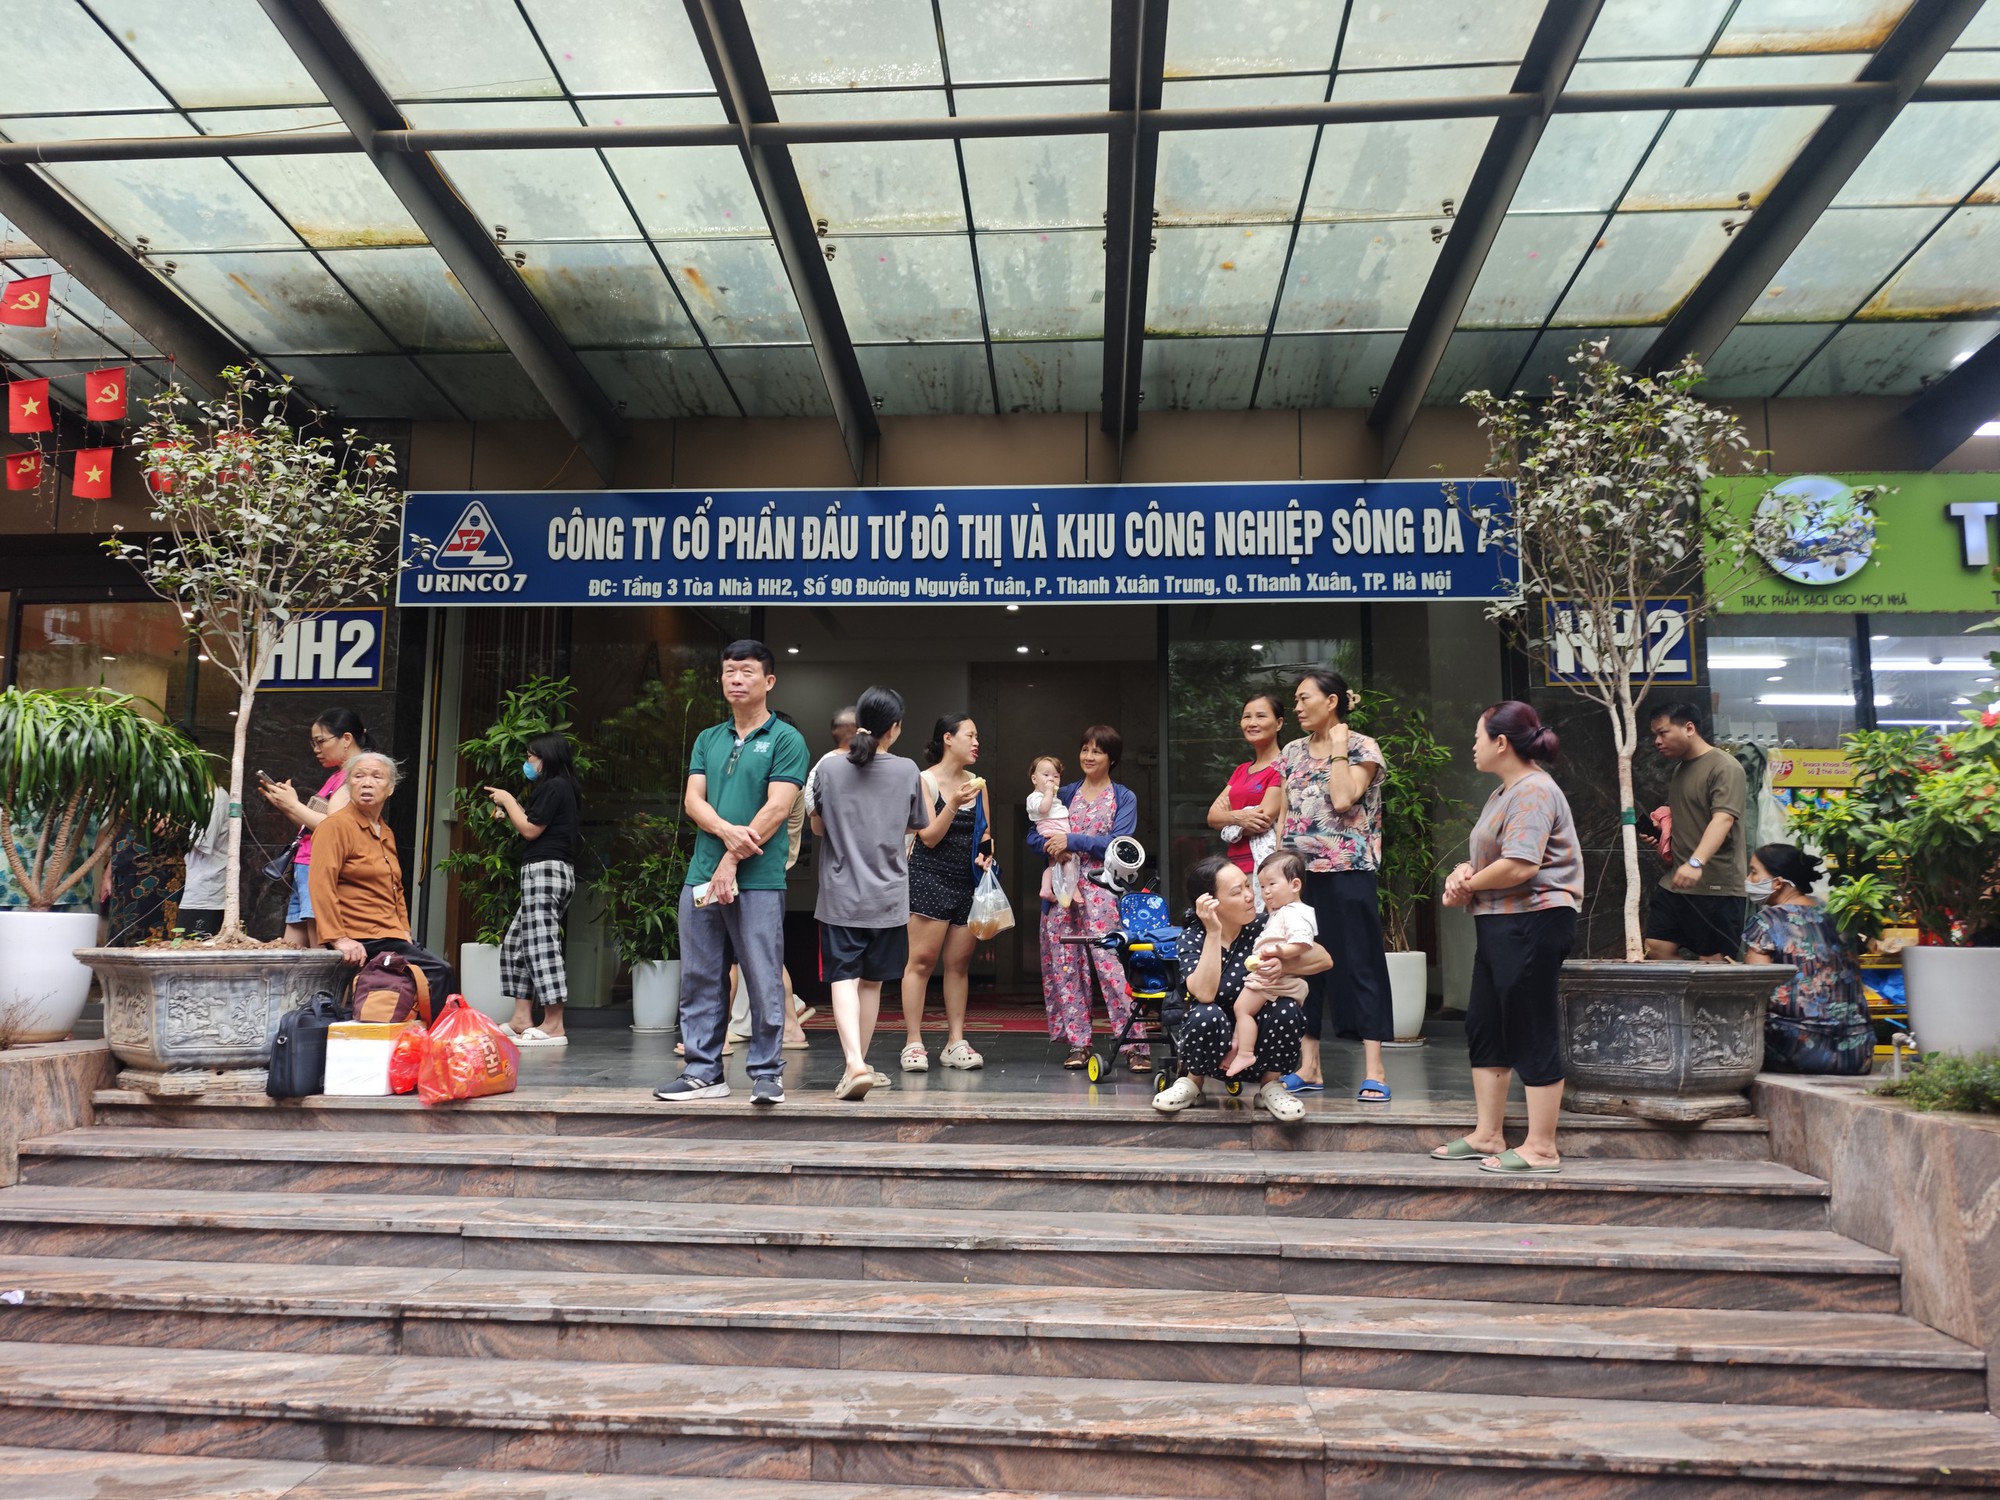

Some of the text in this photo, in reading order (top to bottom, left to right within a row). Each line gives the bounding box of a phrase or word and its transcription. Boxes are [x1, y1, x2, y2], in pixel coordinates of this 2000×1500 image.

[547, 507, 625, 561] CÔNG
[632, 517, 666, 560] TY
[673, 496, 713, 560] CỔ
[718, 501, 796, 560] PHẦN
[801, 500, 859, 560] ĐẦU
[867, 509, 905, 560] TƯ
[911, 503, 949, 560] ĐÔ
[958, 515, 1002, 568] THỊ
[1010, 503, 1048, 559] VÀ
[1056, 513, 1116, 559] KHU
[1124, 501, 1205, 558] CÔNG
[1214, 499, 1324, 565] NGHIỆP
[1331, 498, 1415, 556] SÔNG
[1471, 508, 1492, 553] 7
[588, 570, 1453, 599] ĐC: Tầng 3 Tòa Nhà HH2, Số 90 Đường Nguyễn Tuân, P. Thanh Xuân Trung, Q. Thanh Xuân, TP. Hà Nội
[1742, 595, 1767, 608] THỰC
[1833, 594, 1857, 606] CHO
[1862, 594, 1883, 607] MỌI
[261, 619, 375, 680] HH2
[1555, 609, 1688, 673] HH2
